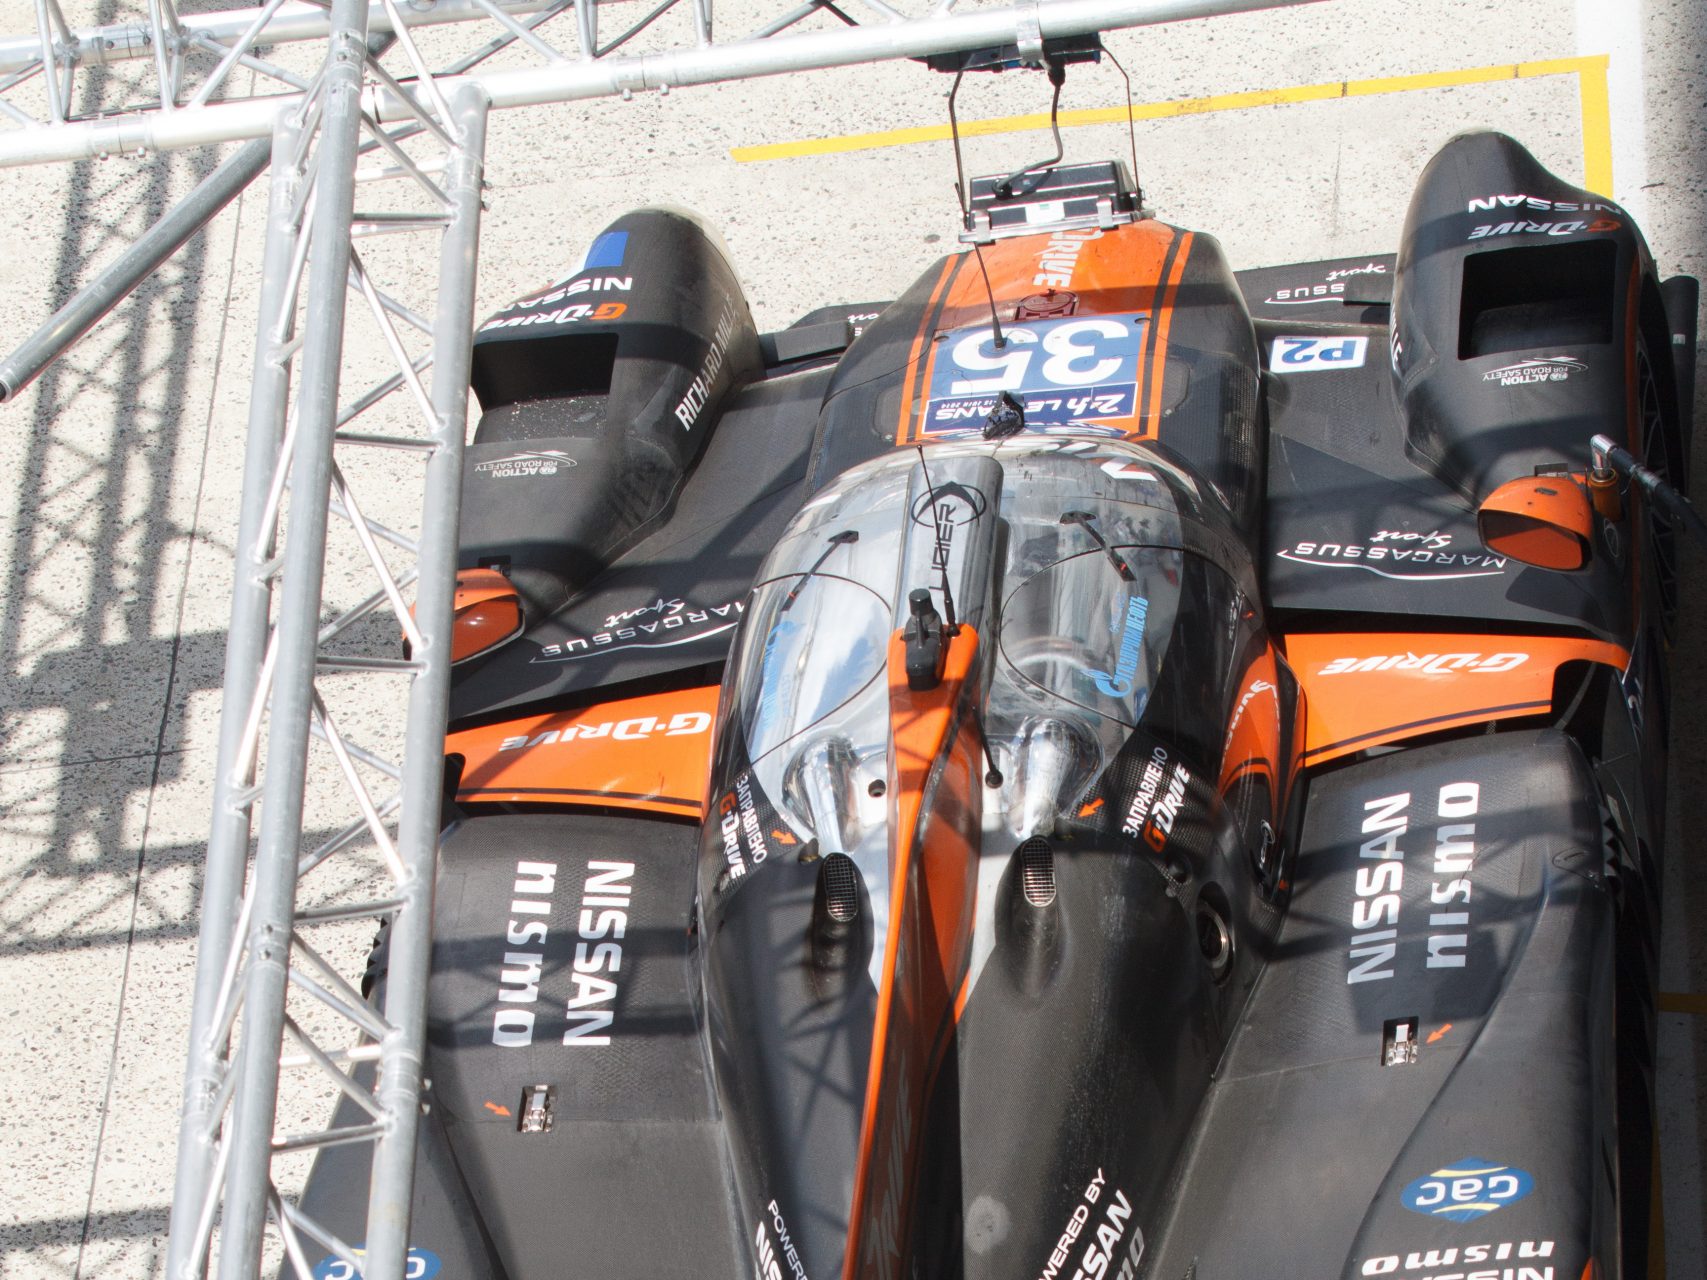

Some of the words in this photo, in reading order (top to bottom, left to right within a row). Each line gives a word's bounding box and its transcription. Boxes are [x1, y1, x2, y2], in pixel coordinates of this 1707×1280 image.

[1468, 195, 1623, 215] NISSAN
[952, 319, 1129, 395] 35
[1281, 338, 1358, 365] P2
[1482, 367, 1521, 381] SAFETY
[1501, 373, 1549, 387] ACTION
[1522, 366, 1553, 376] ROAD
[674, 341, 725, 432] RICHARD
[935, 405, 996, 420] ANS
[1023, 399, 1058, 413] LE
[474, 462, 513, 472] SAFETY
[492, 466, 538, 478] ACTION
[1370, 529, 1453, 548] Sport
[1294, 542, 1507, 569] MARCASSUS
[602, 597, 686, 628] Sport
[1122, 746, 1168, 839] ЗАПРАВЛЕНО
[736, 775, 768, 864] ЗАПРАВЛЕНО
[1347, 792, 1411, 984] NISSAN
[562, 860, 636, 1046] NISSAN
[1084, 1167, 1107, 1204] BY
